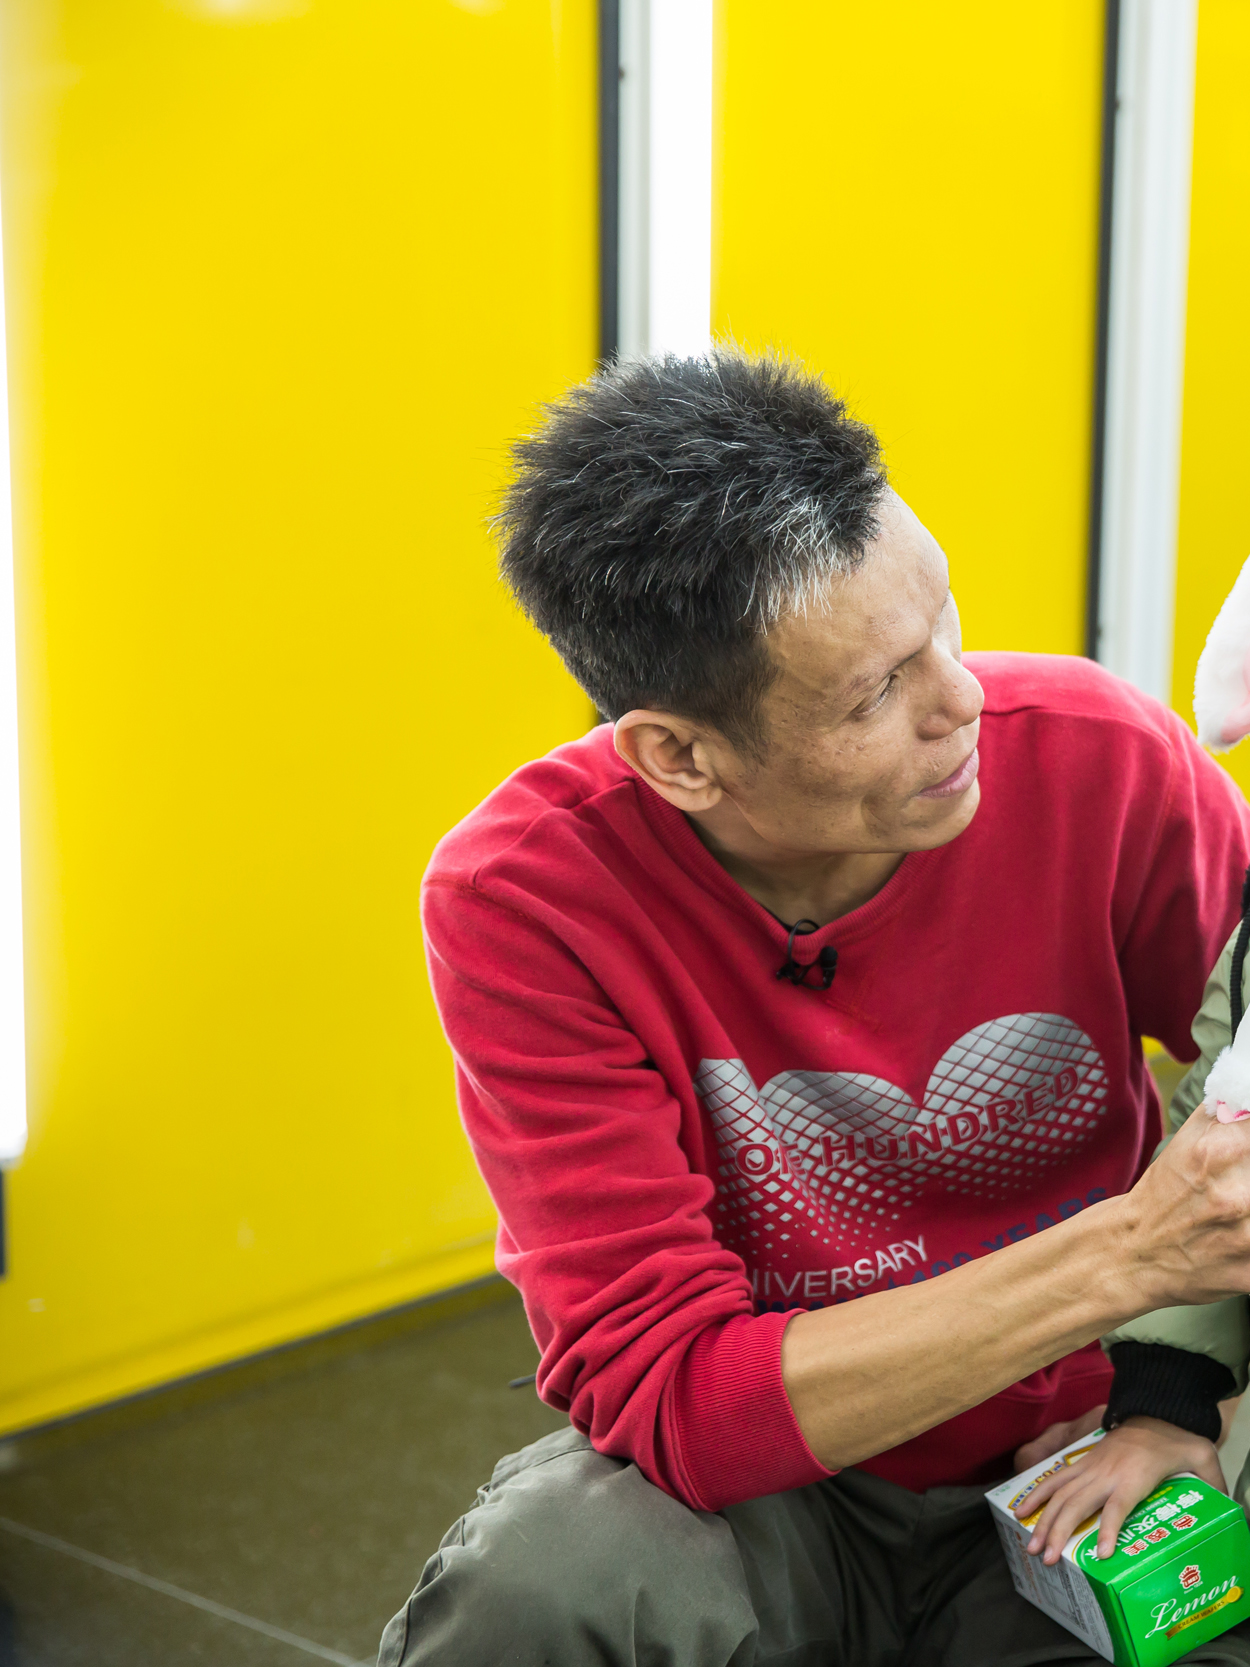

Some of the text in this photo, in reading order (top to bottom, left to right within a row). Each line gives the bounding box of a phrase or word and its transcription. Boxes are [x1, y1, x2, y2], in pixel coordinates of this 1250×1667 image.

[821, 1065, 1079, 1167] HUNDRED
[1121, 1527, 1171, 1556] 義美
[1145, 1575, 1239, 1639] Lemon
